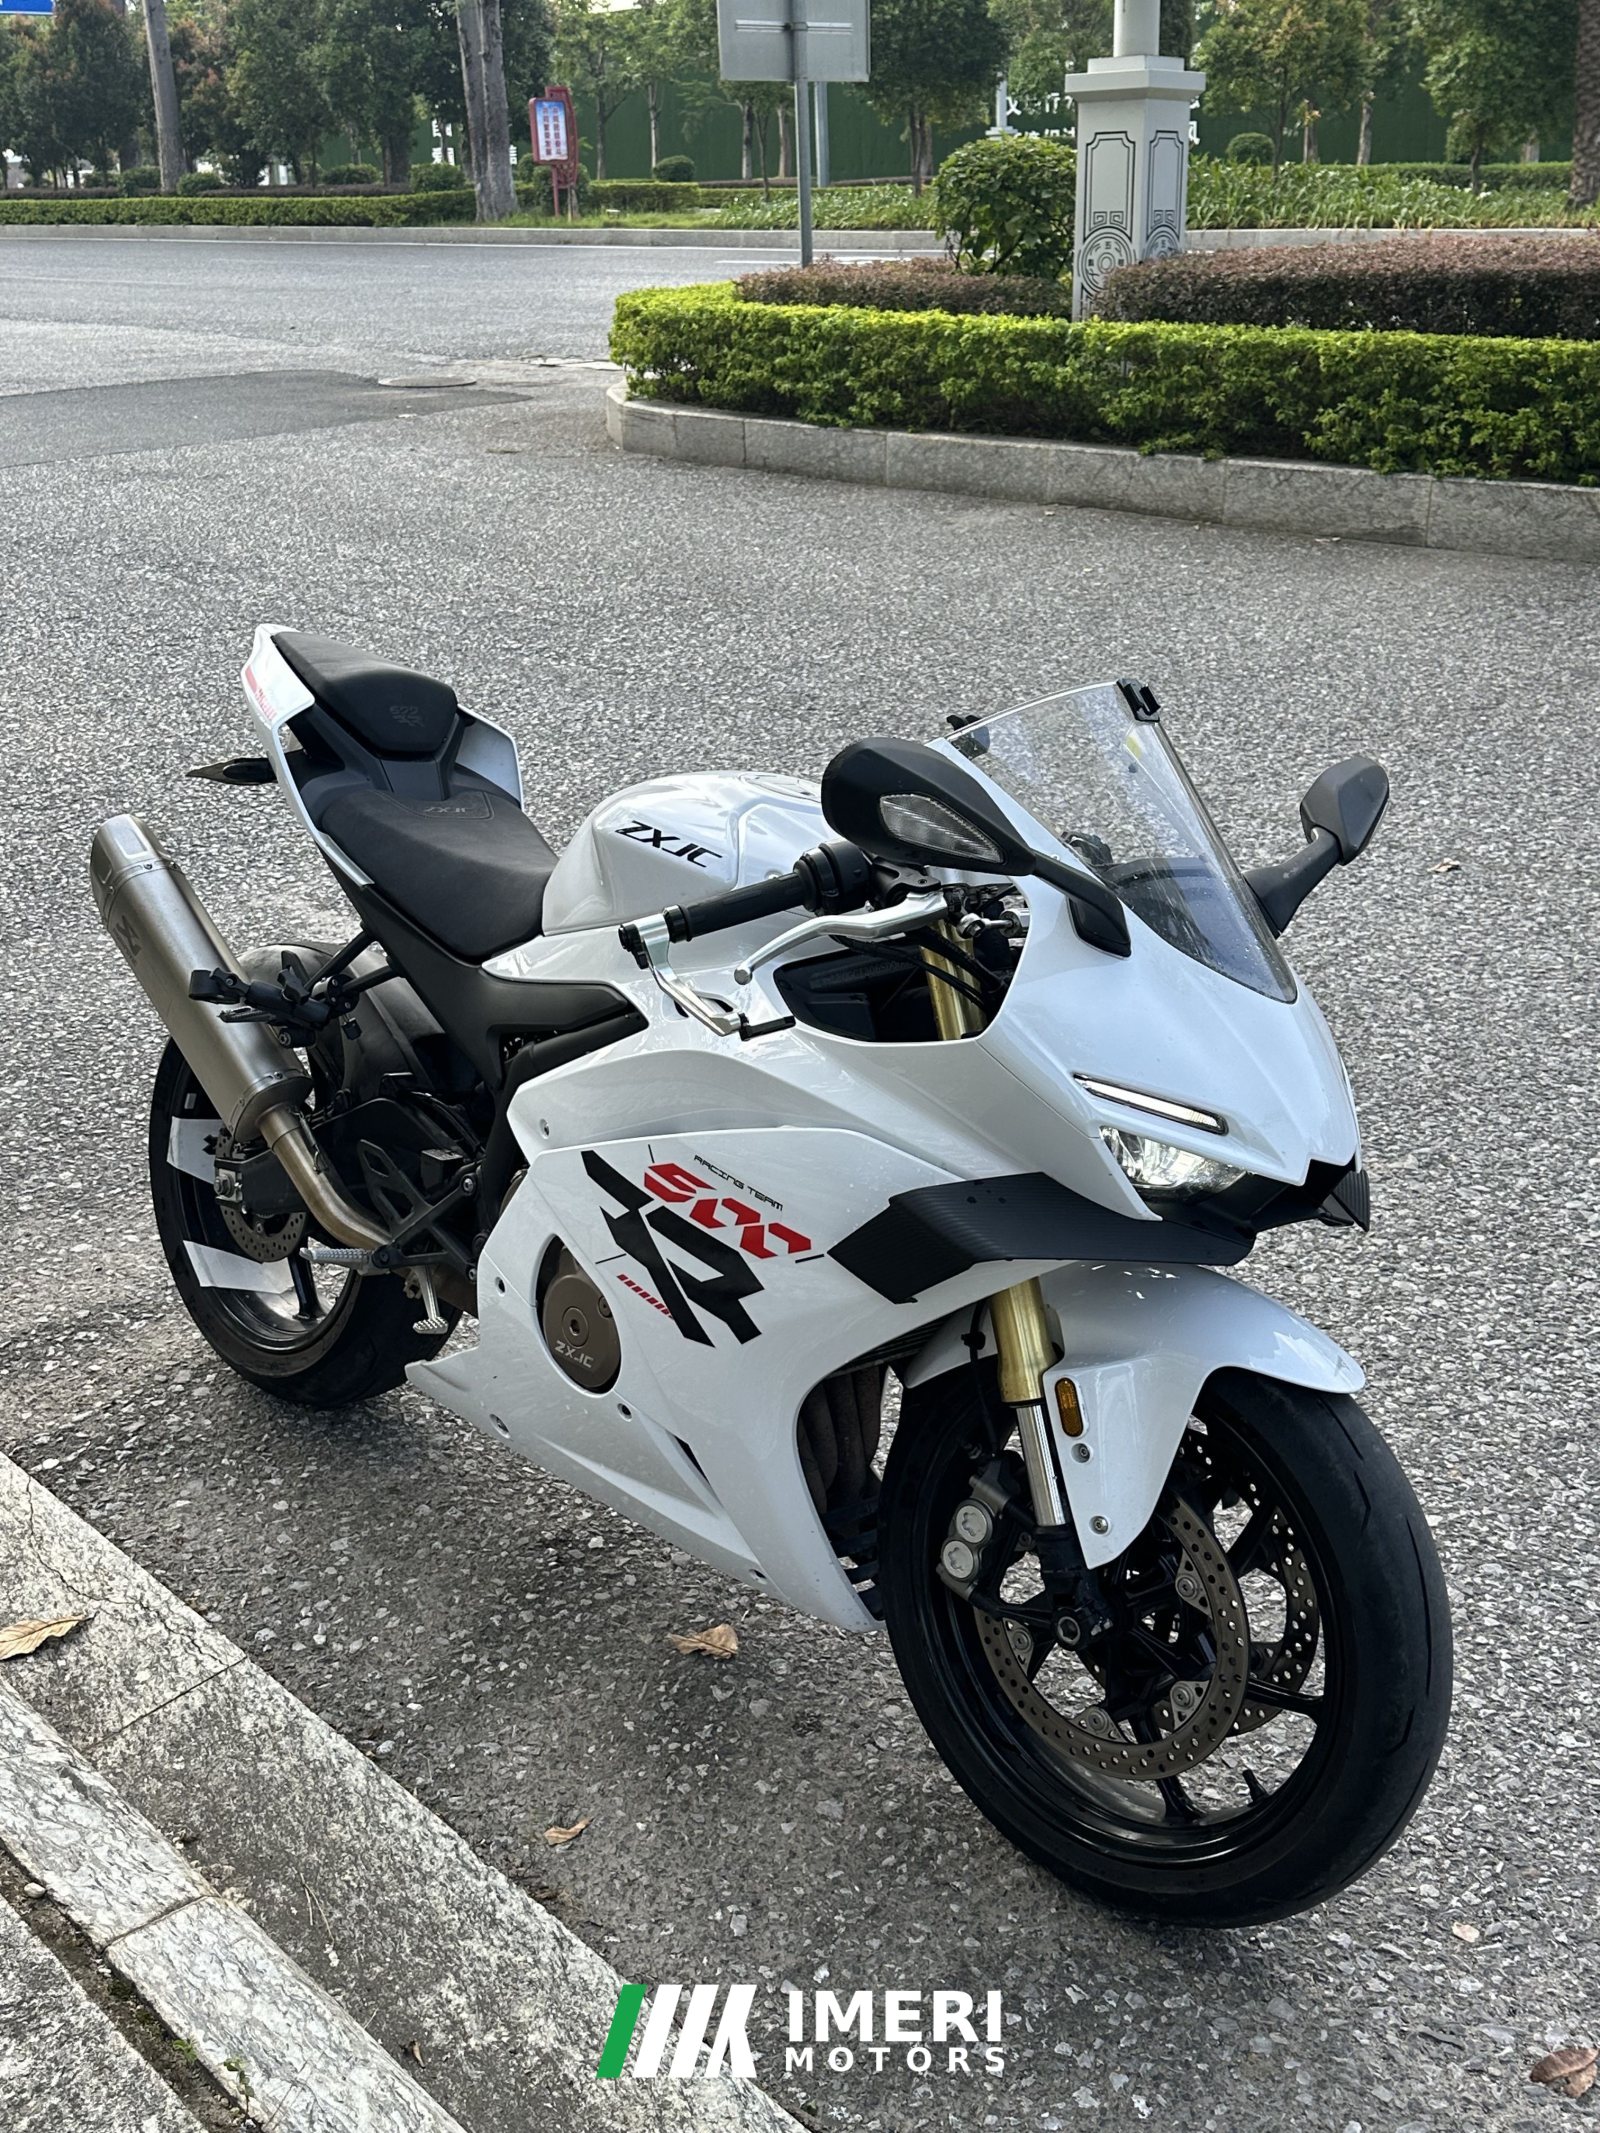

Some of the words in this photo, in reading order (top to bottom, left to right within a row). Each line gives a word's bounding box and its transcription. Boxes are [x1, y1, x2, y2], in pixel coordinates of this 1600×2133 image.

[615, 820, 723, 868] ZXJC
[694, 1155, 745, 1190] RACING
[747, 1186, 783, 1211] TEAM
[643, 1163, 811, 1259] 500
[554, 1340, 594, 1368] ZXJC
